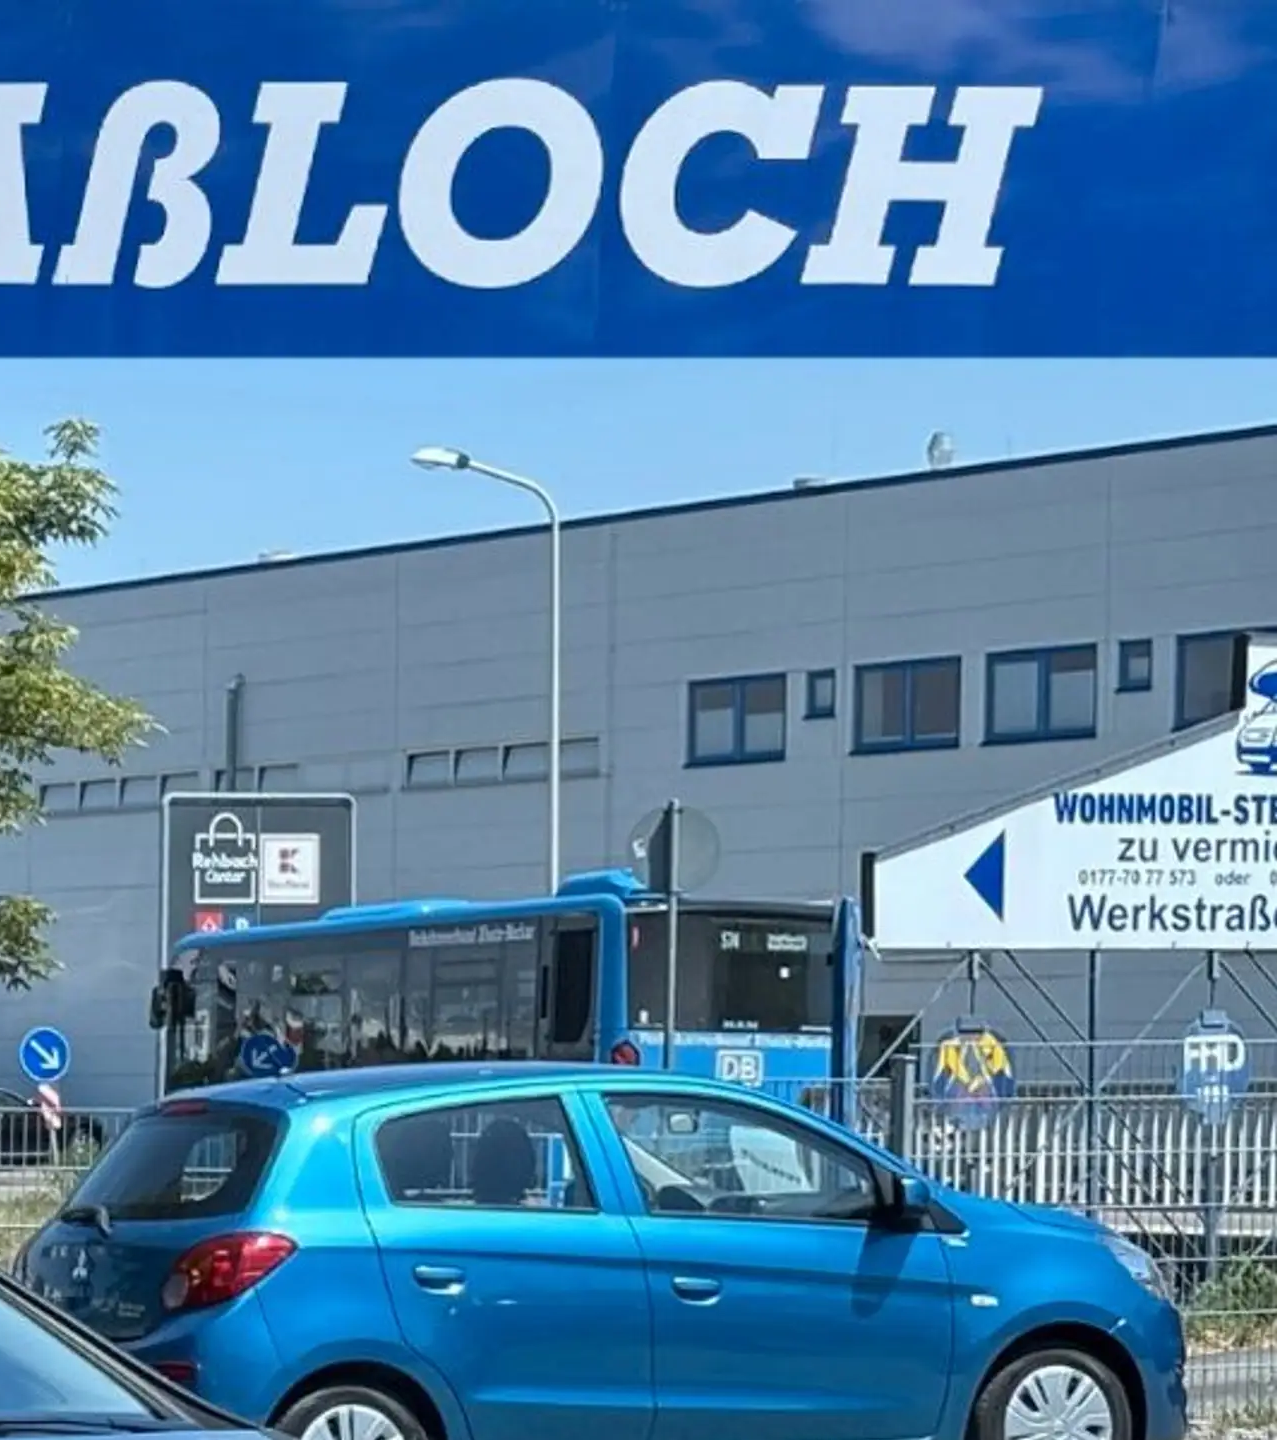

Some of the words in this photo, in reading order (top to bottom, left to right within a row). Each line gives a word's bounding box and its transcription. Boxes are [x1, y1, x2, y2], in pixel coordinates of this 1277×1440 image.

[1117, 837, 1159, 863] zu
[1171, 829, 1277, 863] vermi
[1145, 869, 1165, 886] 77
[1169, 869, 1197, 886] 573
[1214, 869, 1252, 886] oder
[1068, 894, 1277, 932] Werkstraß
[721, 1056, 757, 1080] DB
